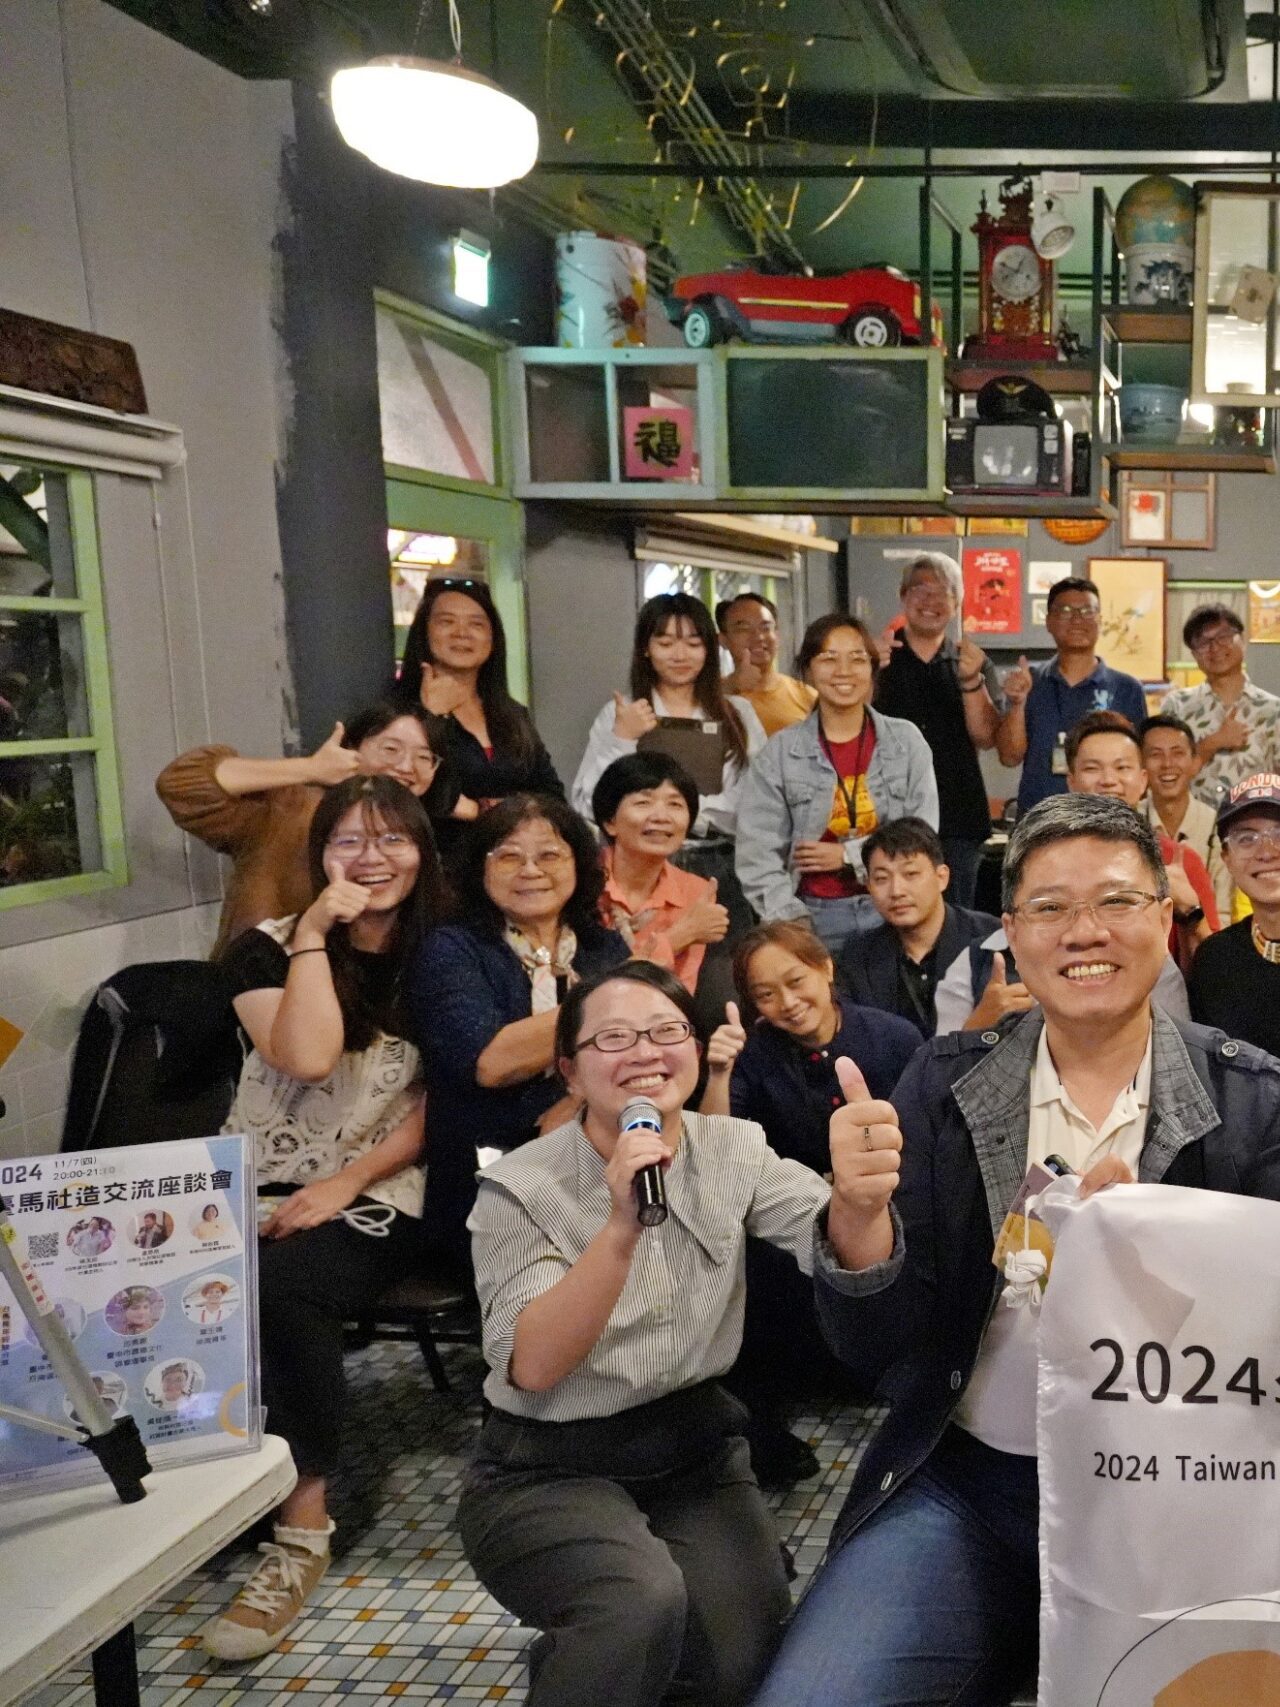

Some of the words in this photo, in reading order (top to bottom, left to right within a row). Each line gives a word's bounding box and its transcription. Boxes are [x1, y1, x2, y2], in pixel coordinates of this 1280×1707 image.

[633, 418, 682, 468] 福
[1093, 1451, 1160, 1482] 2024
[1175, 1453, 1276, 1482] Taiwan
